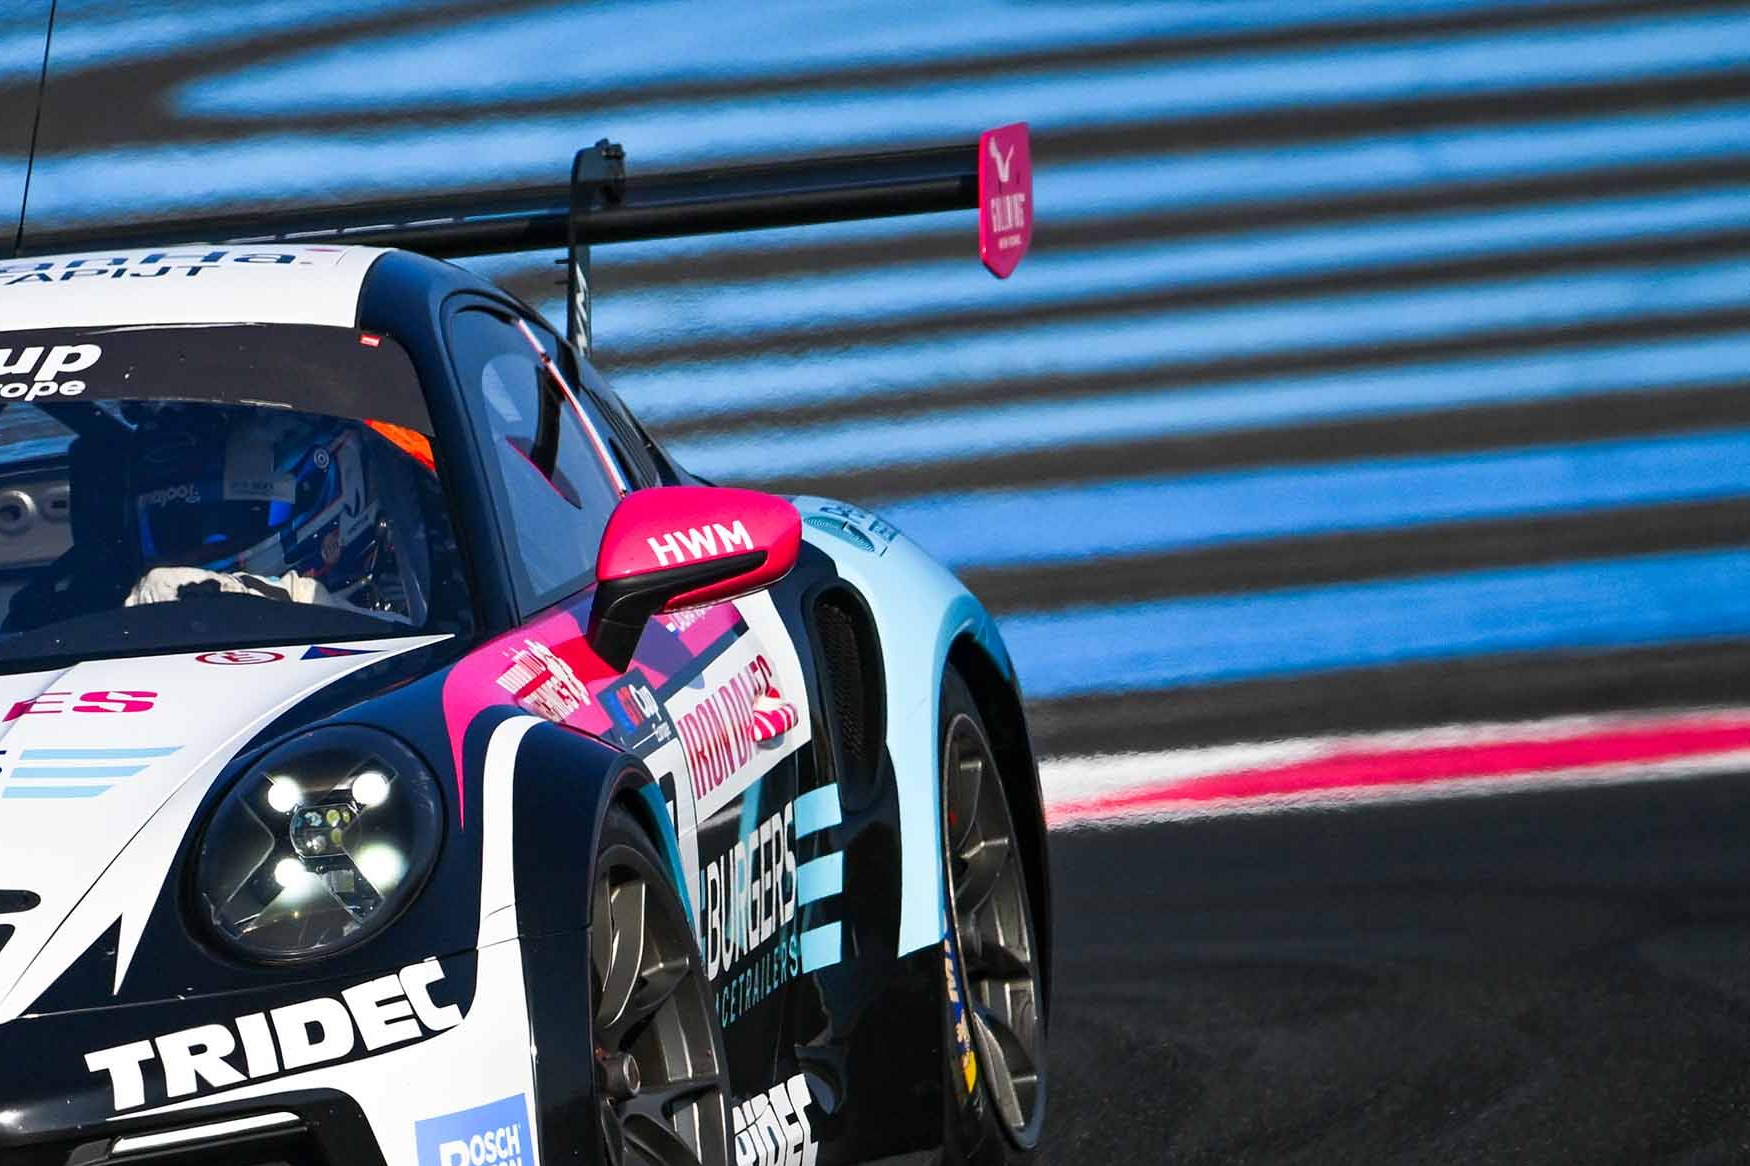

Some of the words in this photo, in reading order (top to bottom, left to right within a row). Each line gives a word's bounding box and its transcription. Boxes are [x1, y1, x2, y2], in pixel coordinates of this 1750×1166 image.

[647, 519, 756, 567] HWM
[706, 800, 798, 982] BURGERS
[84, 957, 463, 1111] TRIDEC
[715, 934, 799, 1029] CETRAILERS
